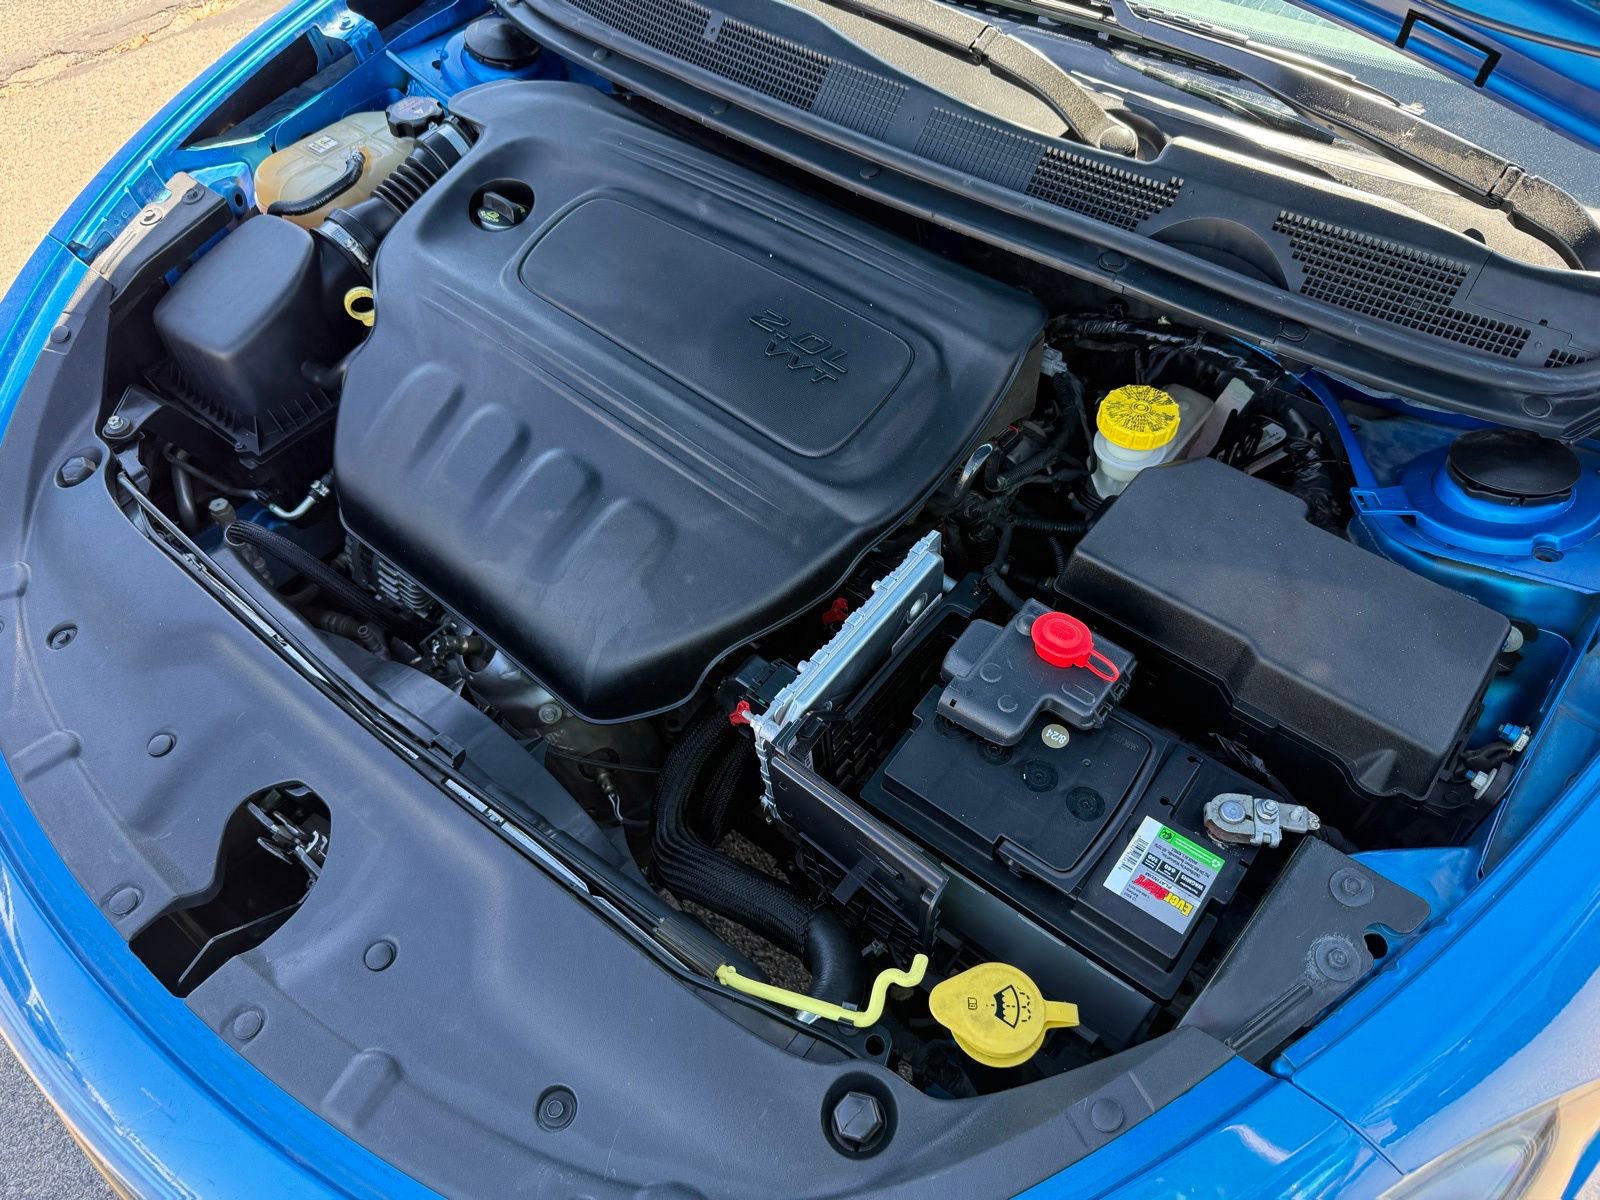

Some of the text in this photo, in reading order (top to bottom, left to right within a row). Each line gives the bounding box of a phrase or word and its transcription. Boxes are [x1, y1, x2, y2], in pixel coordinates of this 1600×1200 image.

[748, 309, 849, 373] 2.0L
[764, 340, 839, 383] VVT
[1046, 729, 1067, 744] 8/24
[1147, 854, 1159, 863] 100
[1163, 864, 1176, 874] 640
[1145, 871, 1172, 890] PLATINUM
[1133, 873, 1194, 917] EverStart
